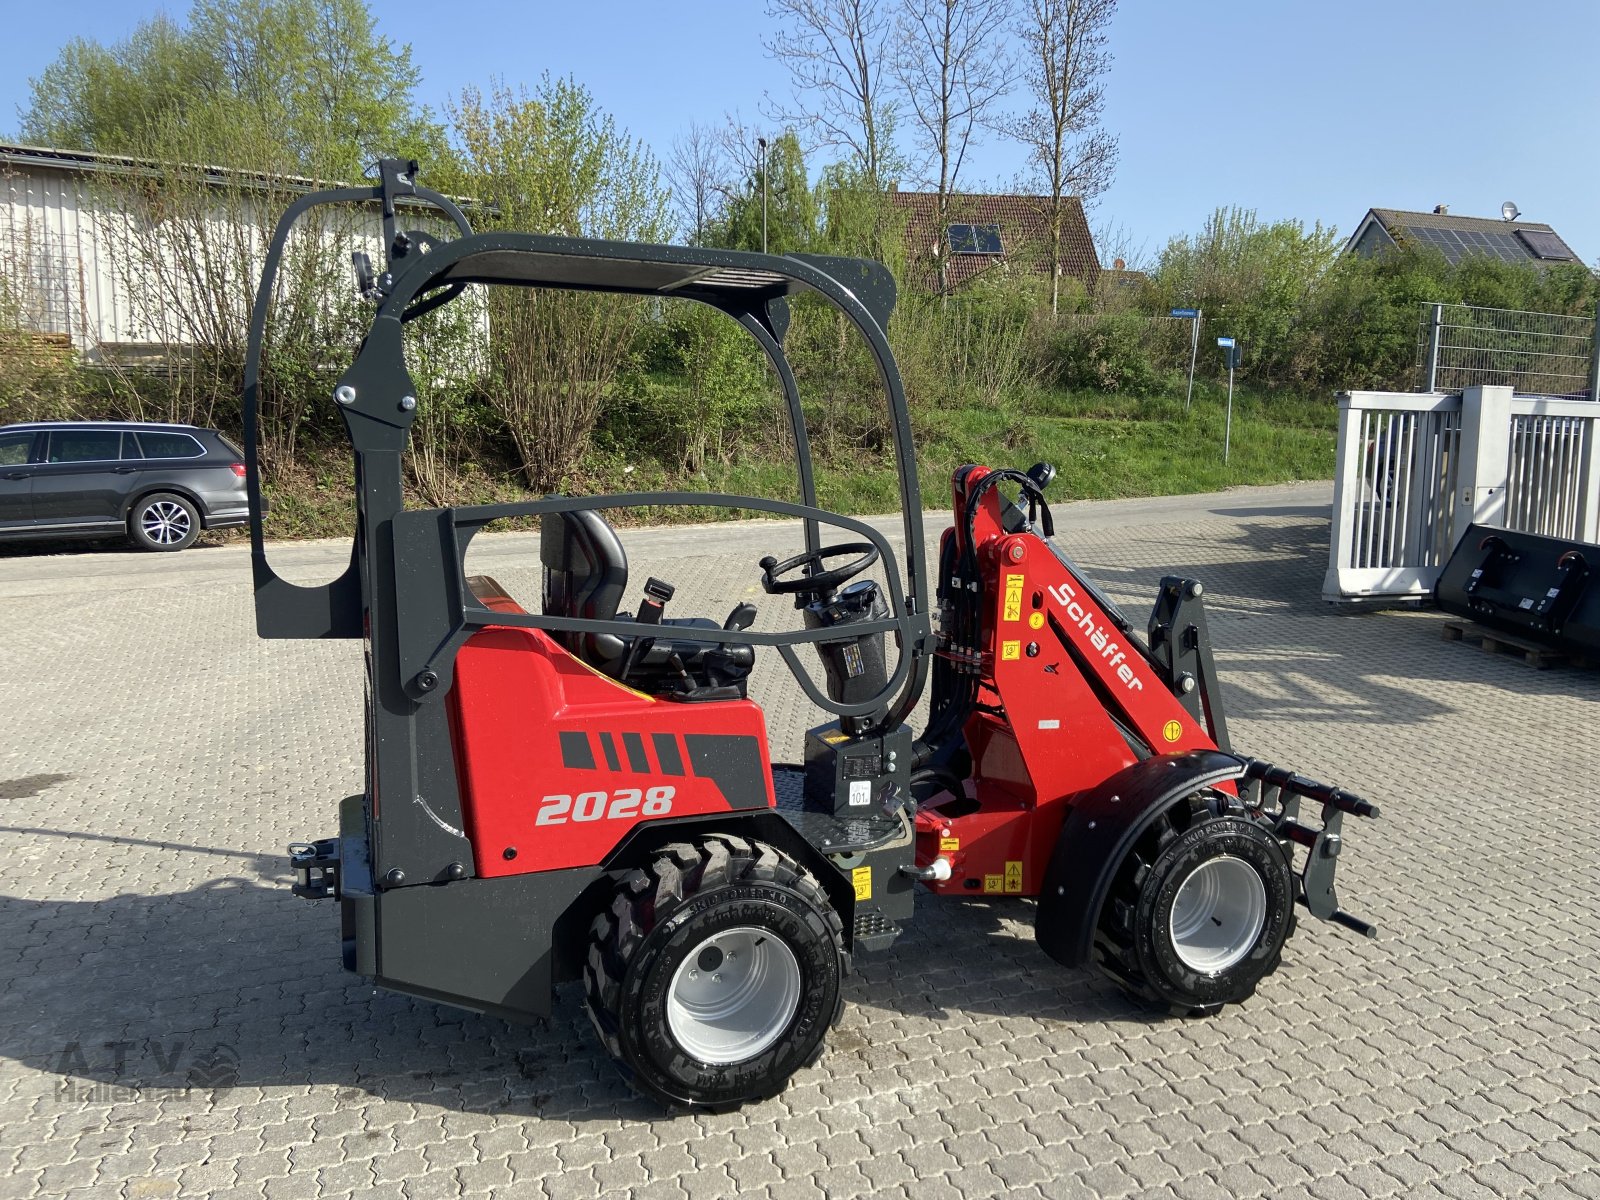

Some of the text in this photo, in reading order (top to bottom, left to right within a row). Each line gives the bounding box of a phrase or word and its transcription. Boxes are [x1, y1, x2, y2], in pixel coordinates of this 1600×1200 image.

[1048, 583, 1144, 691] Schäffer
[535, 785, 676, 826] 2028
[851, 792, 866, 804] 101
[1183, 829, 1205, 845] SKID
[1205, 821, 1238, 834] POWER
[720, 888, 765, 903] POWER
